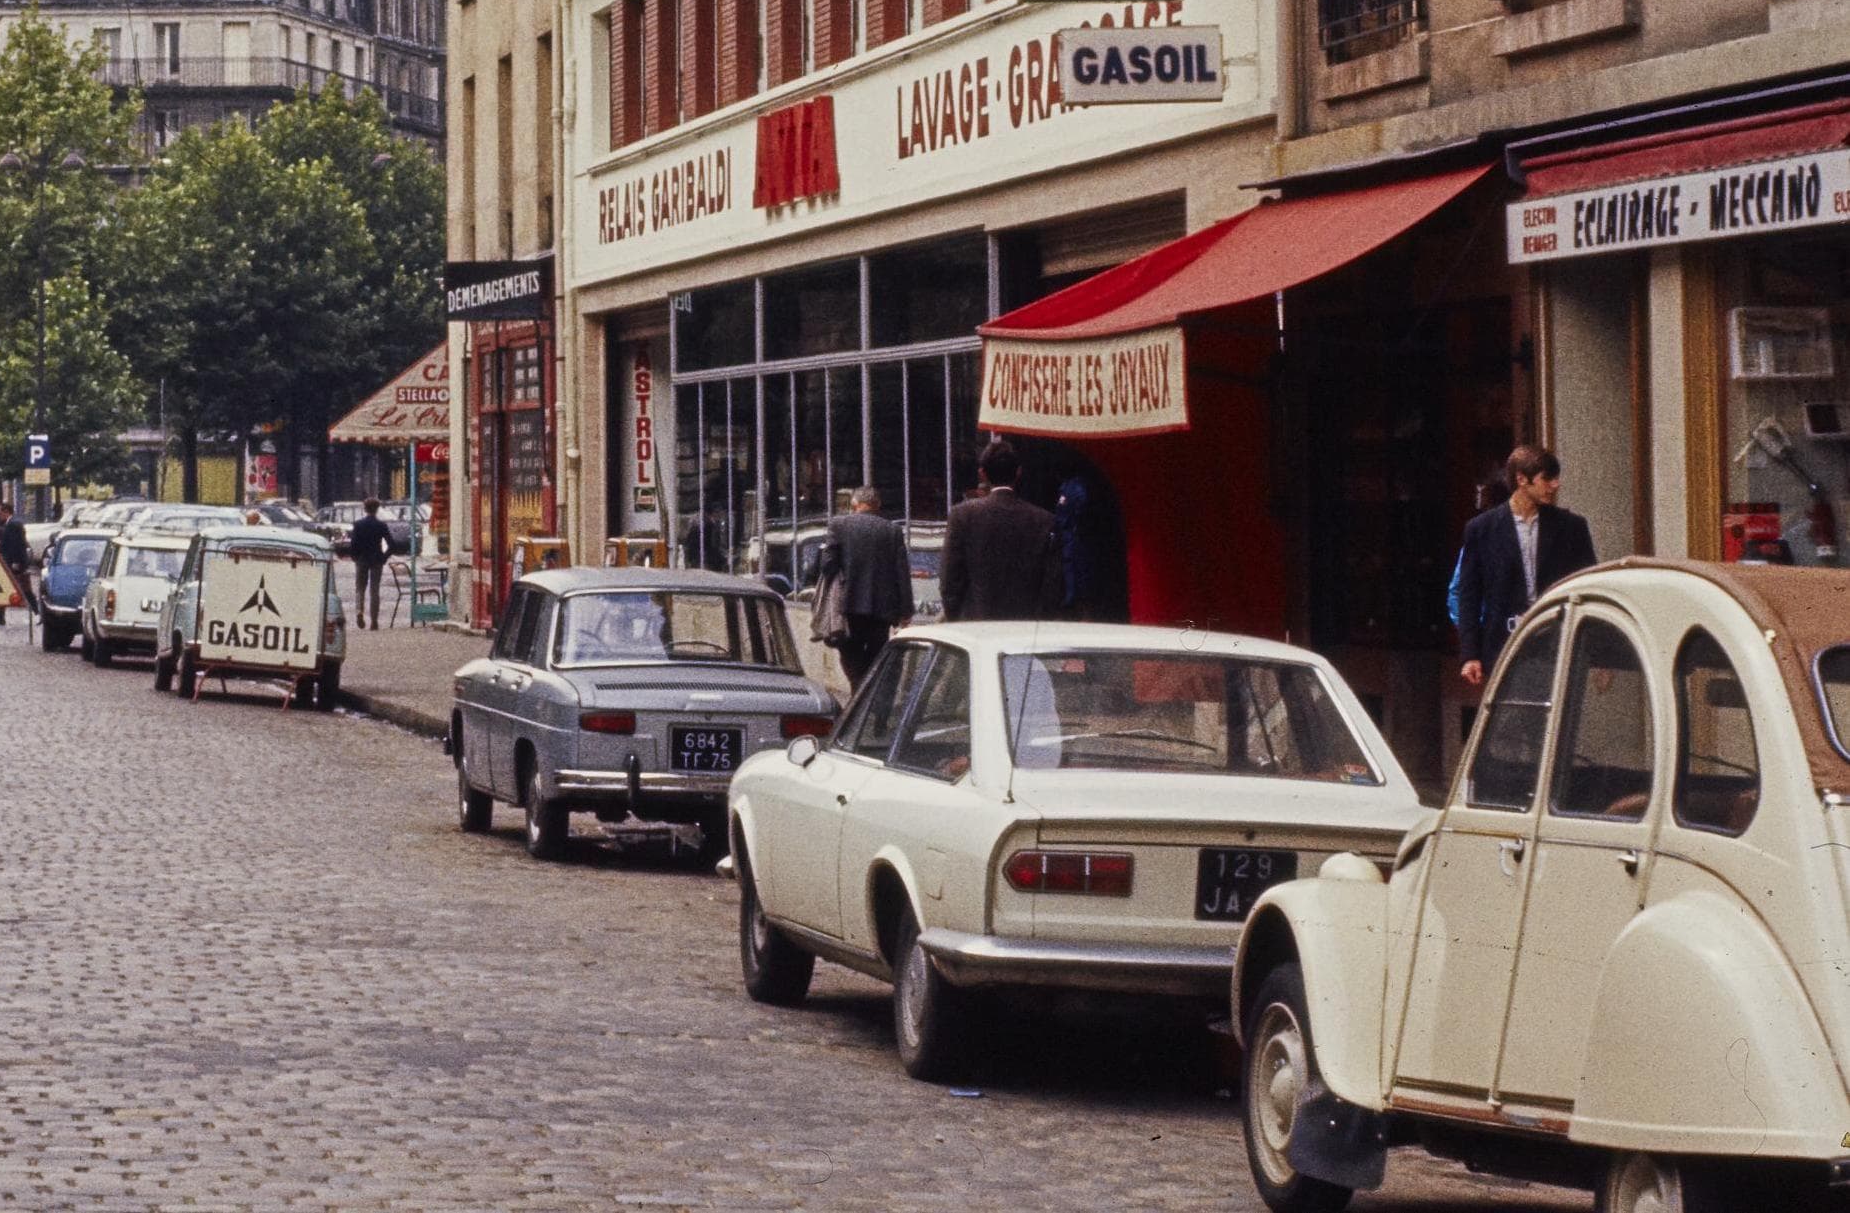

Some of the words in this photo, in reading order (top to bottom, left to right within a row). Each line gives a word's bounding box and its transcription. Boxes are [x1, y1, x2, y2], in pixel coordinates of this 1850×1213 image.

[1072, 44, 1217, 85] GASOIL
[897, 57, 990, 159] LAVAGE
[599, 176, 646, 245] RELAIS
[651, 146, 731, 232] GARIBALDI
[1574, 185, 1681, 248] ECLAIRAGE
[1709, 162, 1821, 231] MECCANO
[988, 352, 1072, 416] CONFISERIE
[1078, 355, 1104, 417] LES
[1109, 341, 1170, 416] JOYAUX
[30, 445, 45, 465] P
[208, 620, 309, 654] GASOIL
[684, 732, 730, 750] 6842
